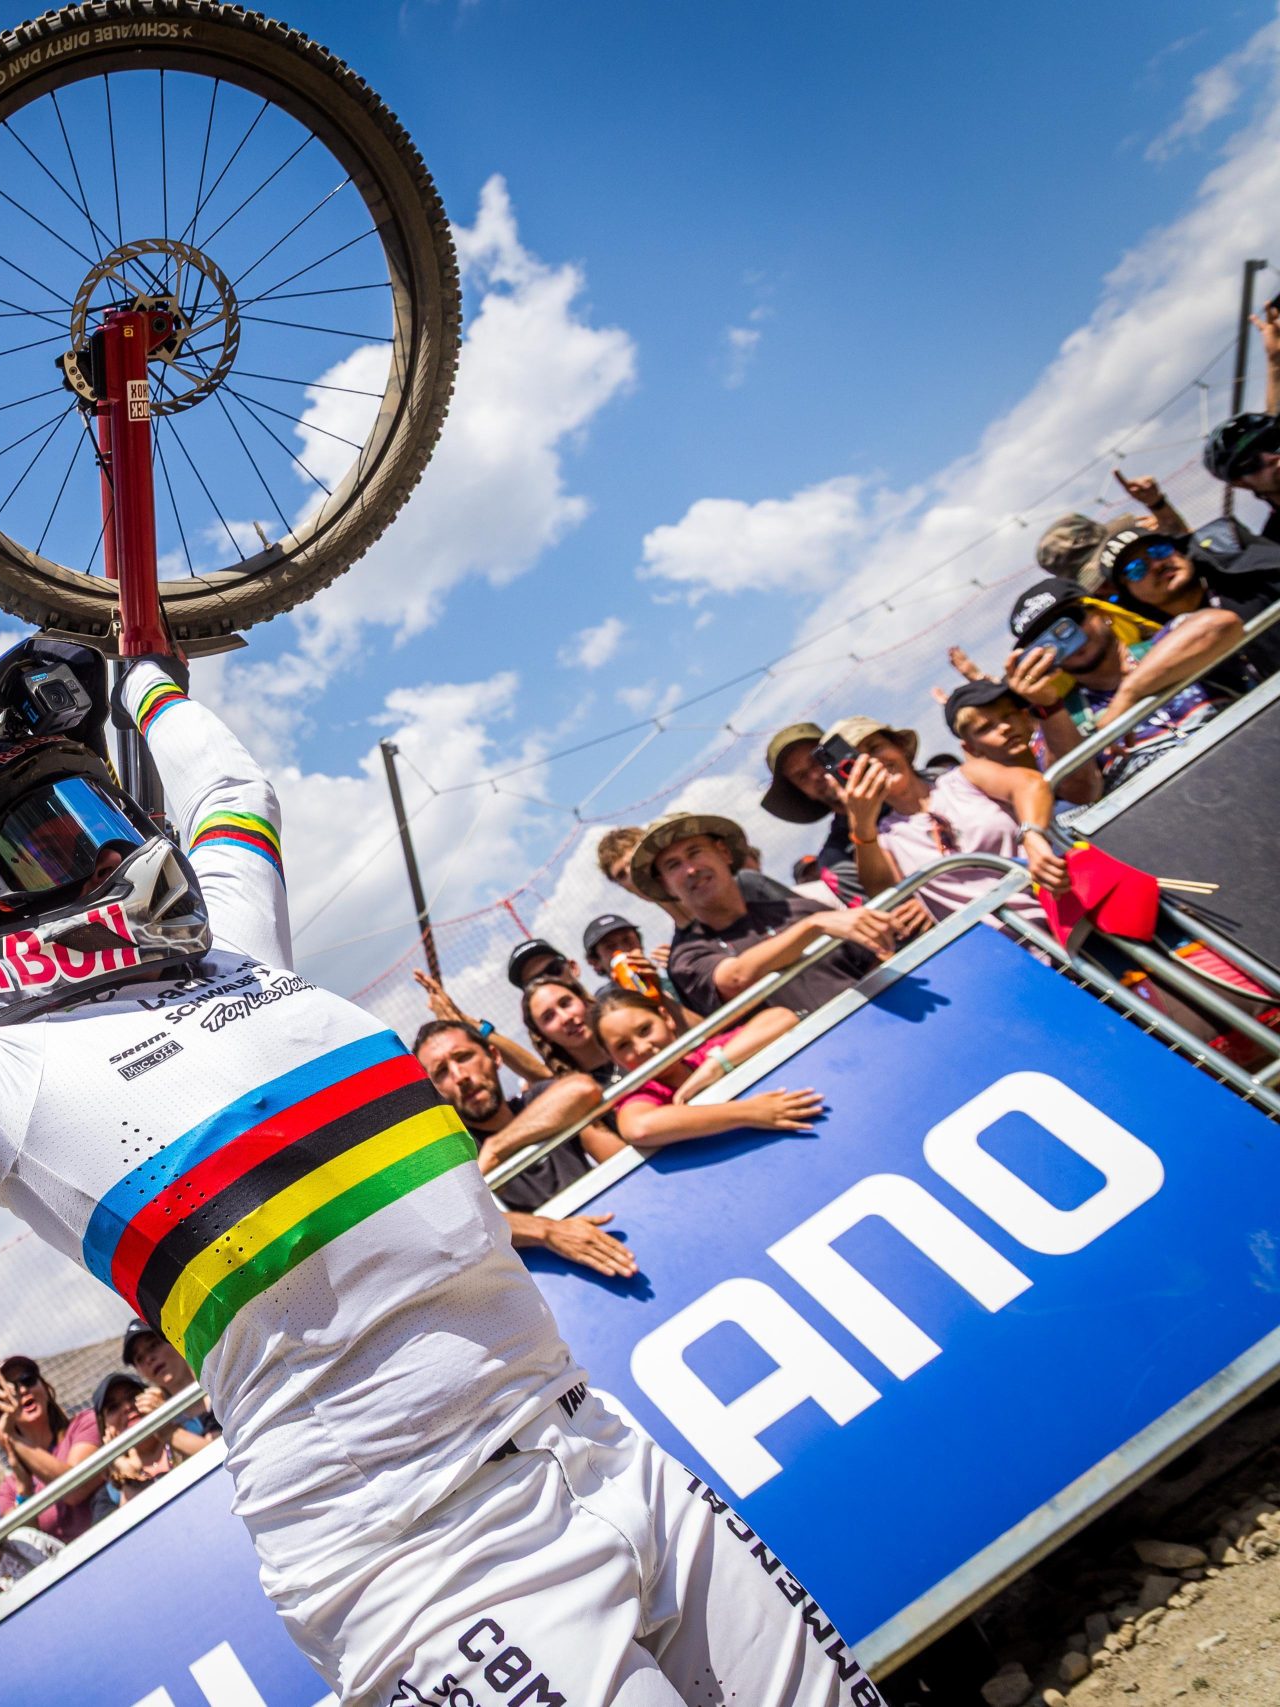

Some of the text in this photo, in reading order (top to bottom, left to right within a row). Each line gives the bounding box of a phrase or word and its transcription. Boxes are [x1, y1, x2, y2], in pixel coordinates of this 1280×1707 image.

[45, 30, 90, 60] DIRTY
[94, 22, 179, 43] SCHWALBE
[8, 52, 42, 78] DAN
[131, 384, 150, 399] HOX
[131, 402, 150, 418] OCK
[4, 903, 138, 988] Bull
[165, 974, 260, 1025] SCHWALBE
[200, 1000, 251, 1033] Troy
[245, 989, 282, 1012] Lee
[109, 1031, 166, 1065] SRAM
[124, 1042, 181, 1078] Muc-Off
[588, 1070, 1165, 1499] ANO
